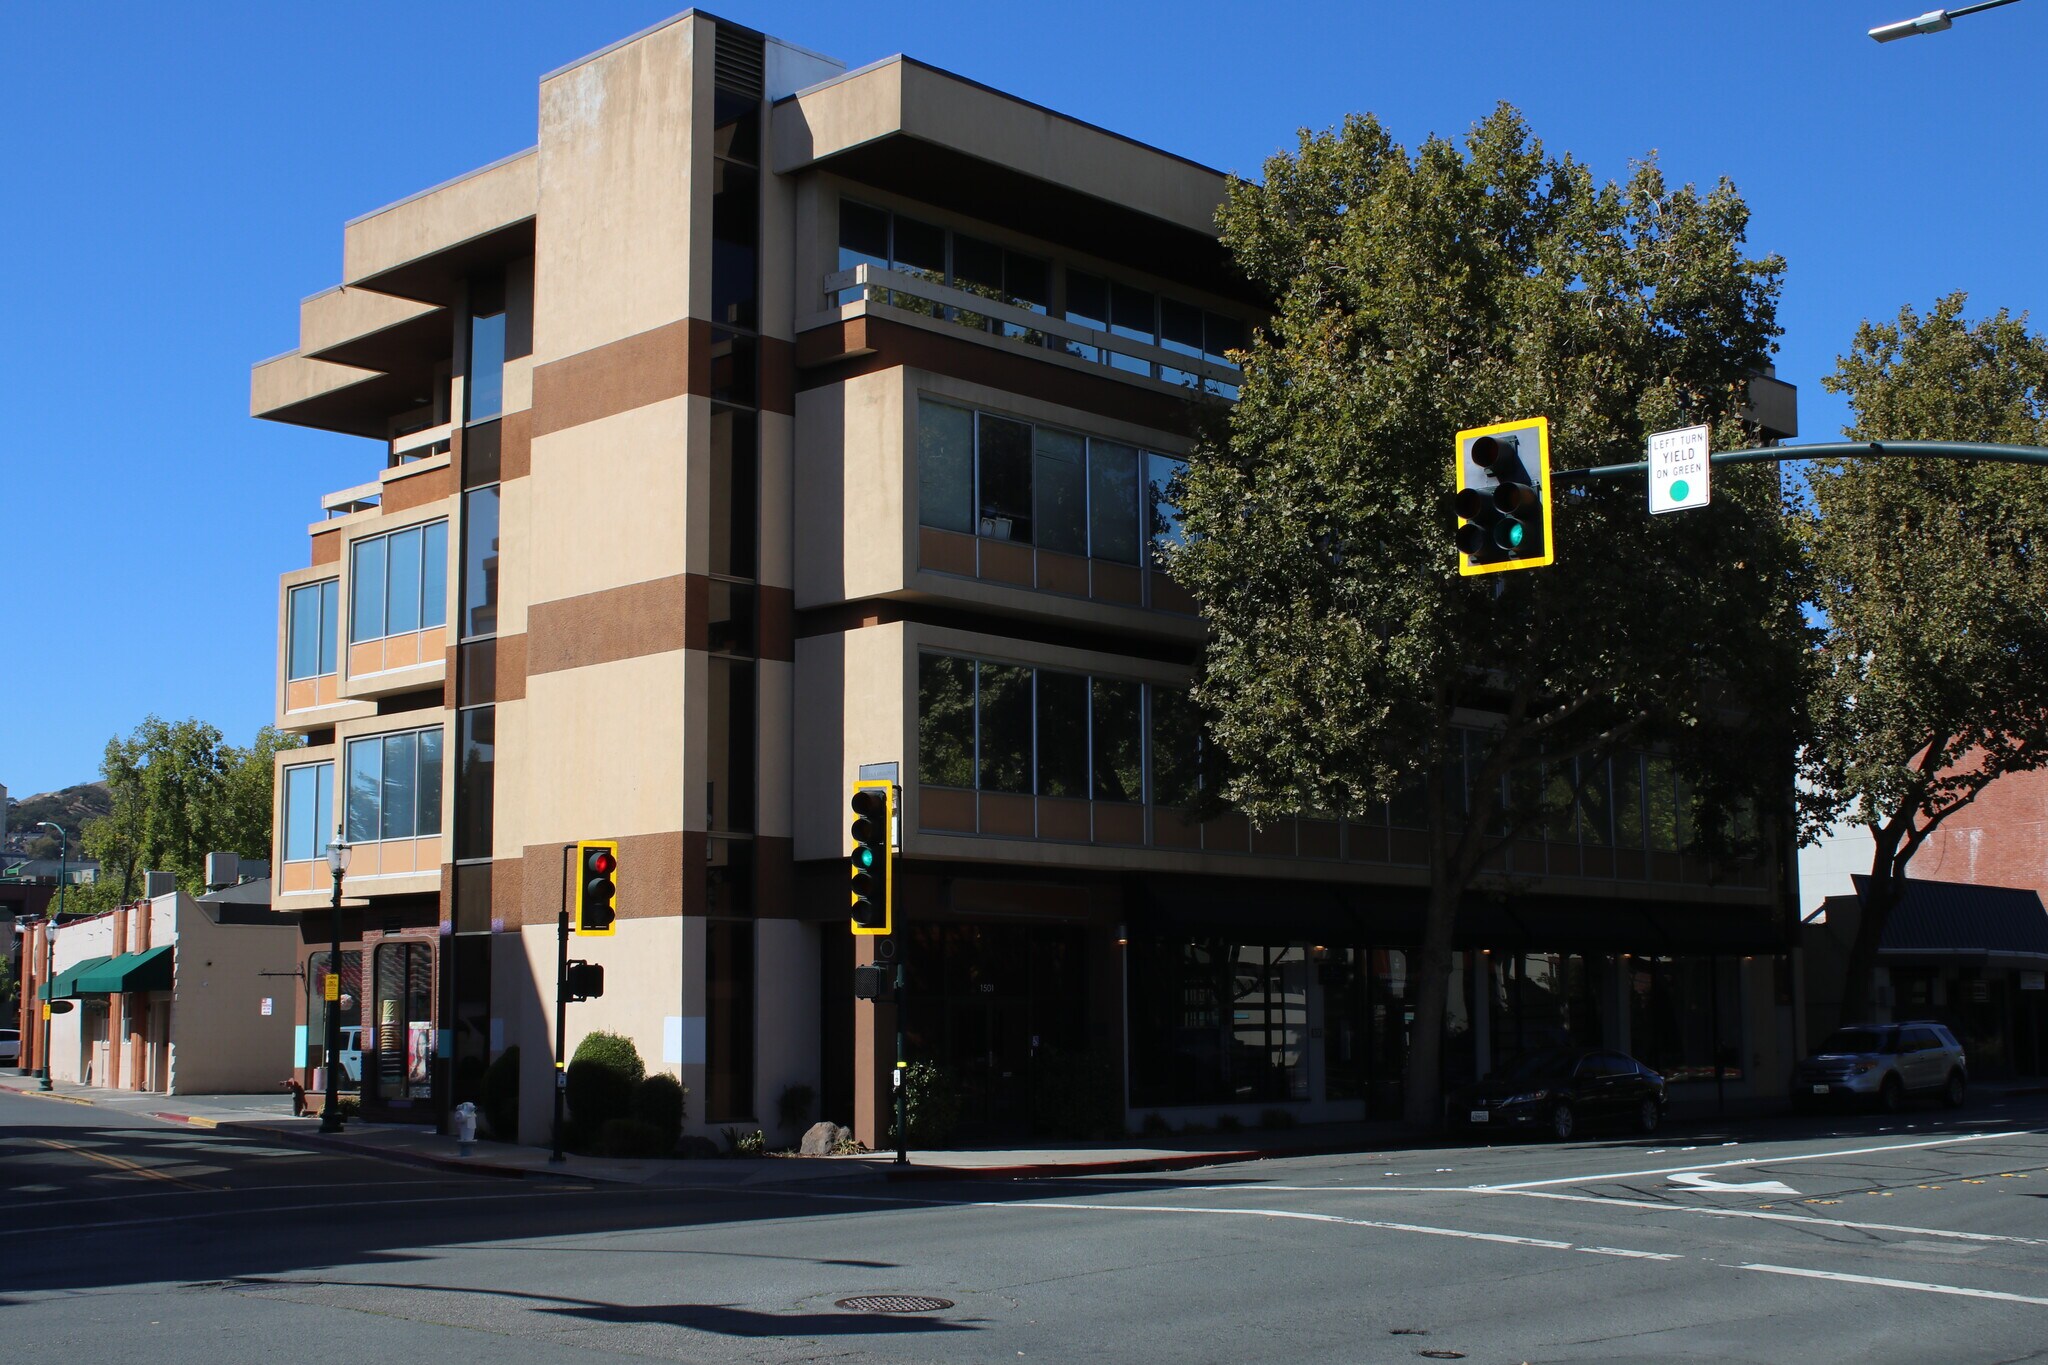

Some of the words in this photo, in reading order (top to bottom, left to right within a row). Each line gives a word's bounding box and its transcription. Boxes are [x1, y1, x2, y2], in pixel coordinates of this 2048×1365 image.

[1654, 438, 1676, 450] LEFT
[1680, 433, 1703, 445] TURN
[1663, 448, 1695, 463] YIELD
[1656, 469, 1668, 479] ON
[1673, 463, 1702, 476] GREEN
[980, 983, 994, 993] 1501
